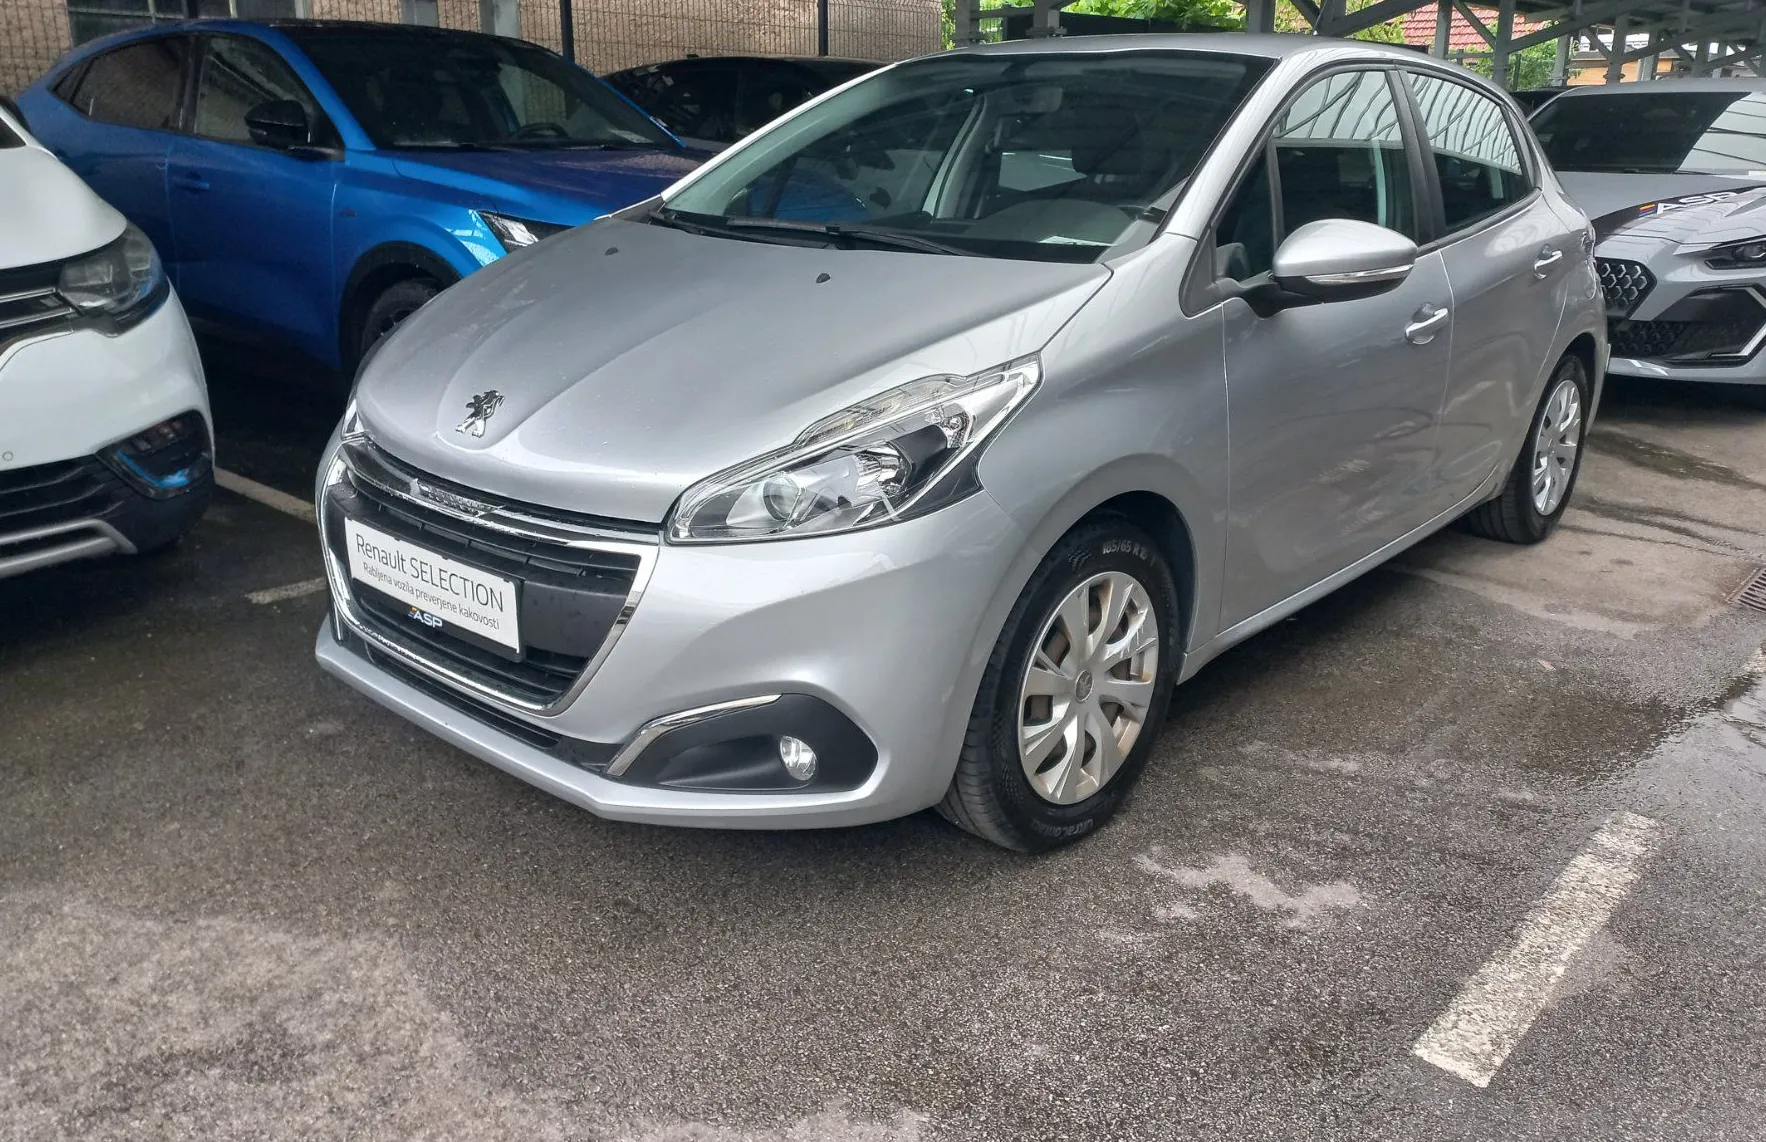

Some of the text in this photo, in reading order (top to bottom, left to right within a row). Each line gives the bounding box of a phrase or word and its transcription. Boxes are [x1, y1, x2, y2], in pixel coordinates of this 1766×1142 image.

[1656, 192, 1739, 216] ASP
[356, 533, 504, 613] Renault SELECTION
[363, 562, 500, 630] Rabljena vozila preverjene kakovosti
[413, 609, 443, 628] ASP
